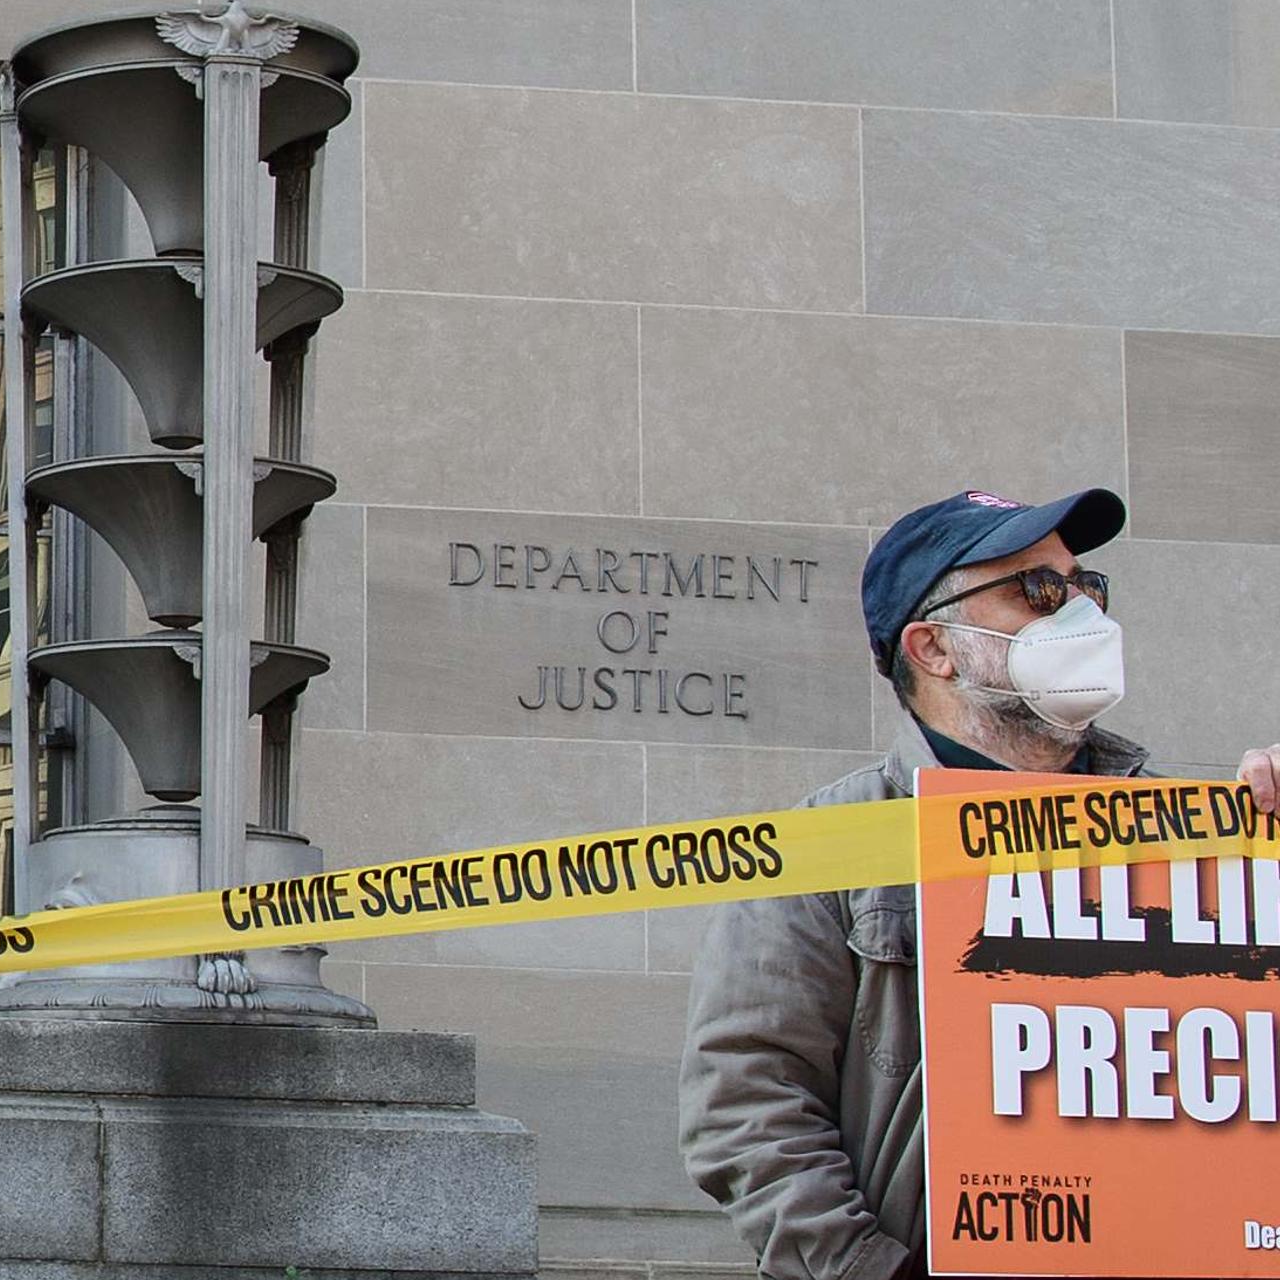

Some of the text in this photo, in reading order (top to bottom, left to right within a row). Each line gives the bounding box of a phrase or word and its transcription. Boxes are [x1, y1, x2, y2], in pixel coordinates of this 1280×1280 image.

[448, 542, 819, 603] DEPARTMENT
[597, 611, 668, 654] OF
[518, 666, 748, 719] JUSTICE
[960, 795, 1082, 859] CRIME
[1084, 787, 1207, 847] SCENE
[222, 822, 783, 932] CRIME SCENE DO NOT CROSS
[983, 851, 1145, 941] ALL
[991, 1003, 1278, 1123] PRECI
[960, 1173, 1093, 1188] DEATH PENALTY
[953, 1188, 1092, 1244] ACTION
